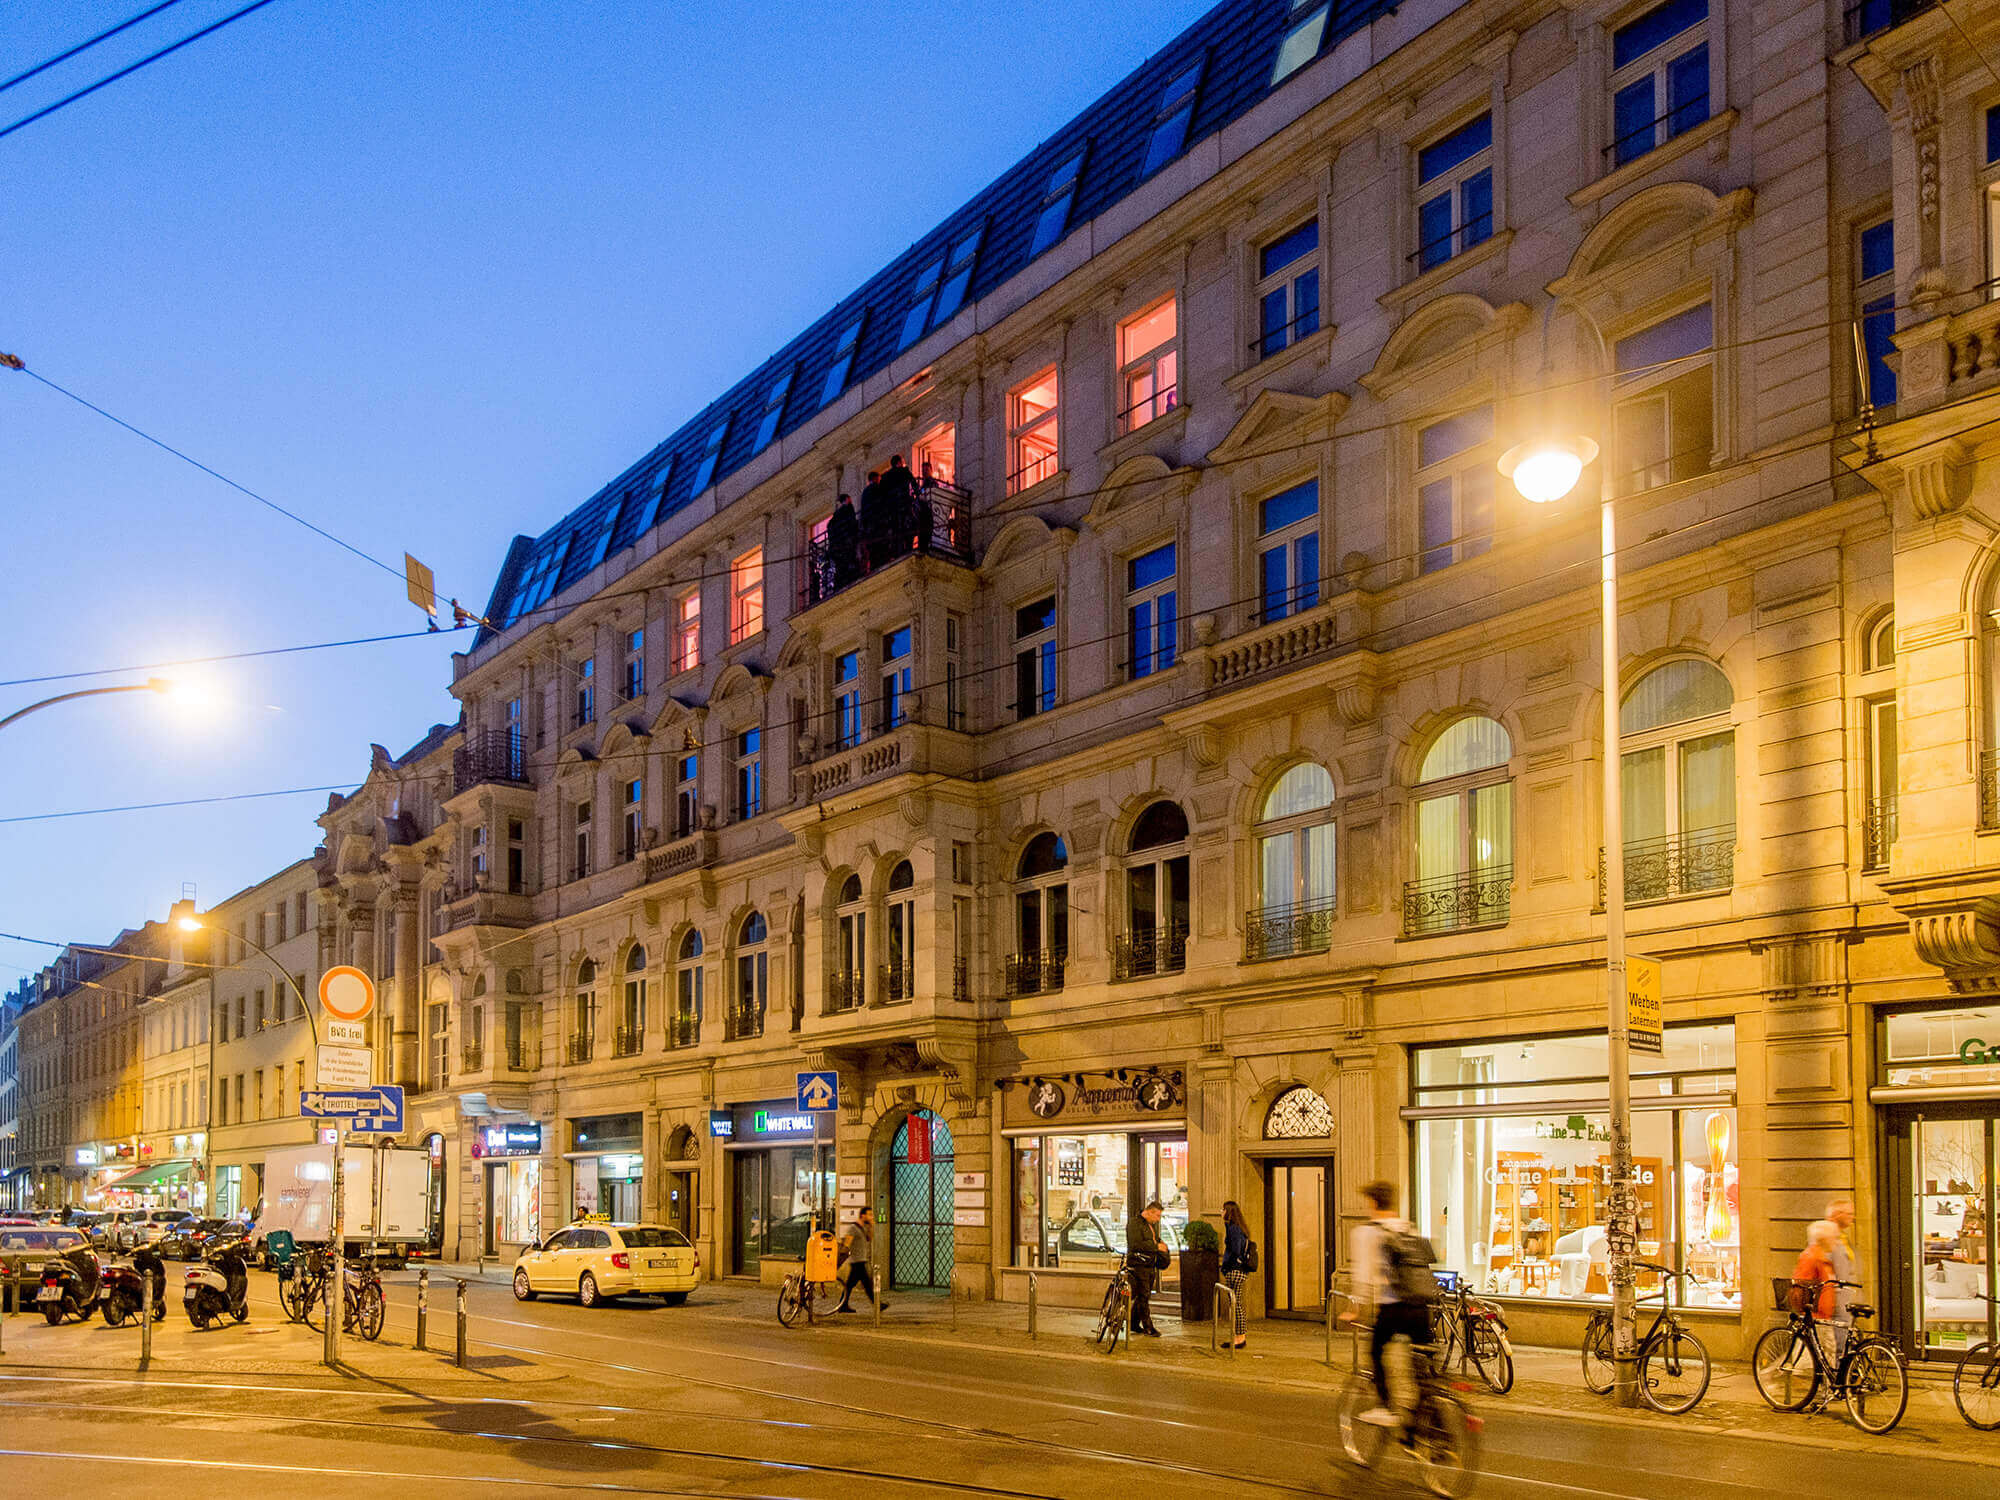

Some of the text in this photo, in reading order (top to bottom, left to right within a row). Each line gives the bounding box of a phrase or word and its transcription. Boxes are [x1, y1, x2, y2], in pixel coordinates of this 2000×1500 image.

[1628, 991, 1660, 1011] Werben
[330, 1026, 363, 1040] BVG frei
[326, 1099, 356, 1110] TROTTEL
[766, 1115, 814, 1131] WHITEWALL
